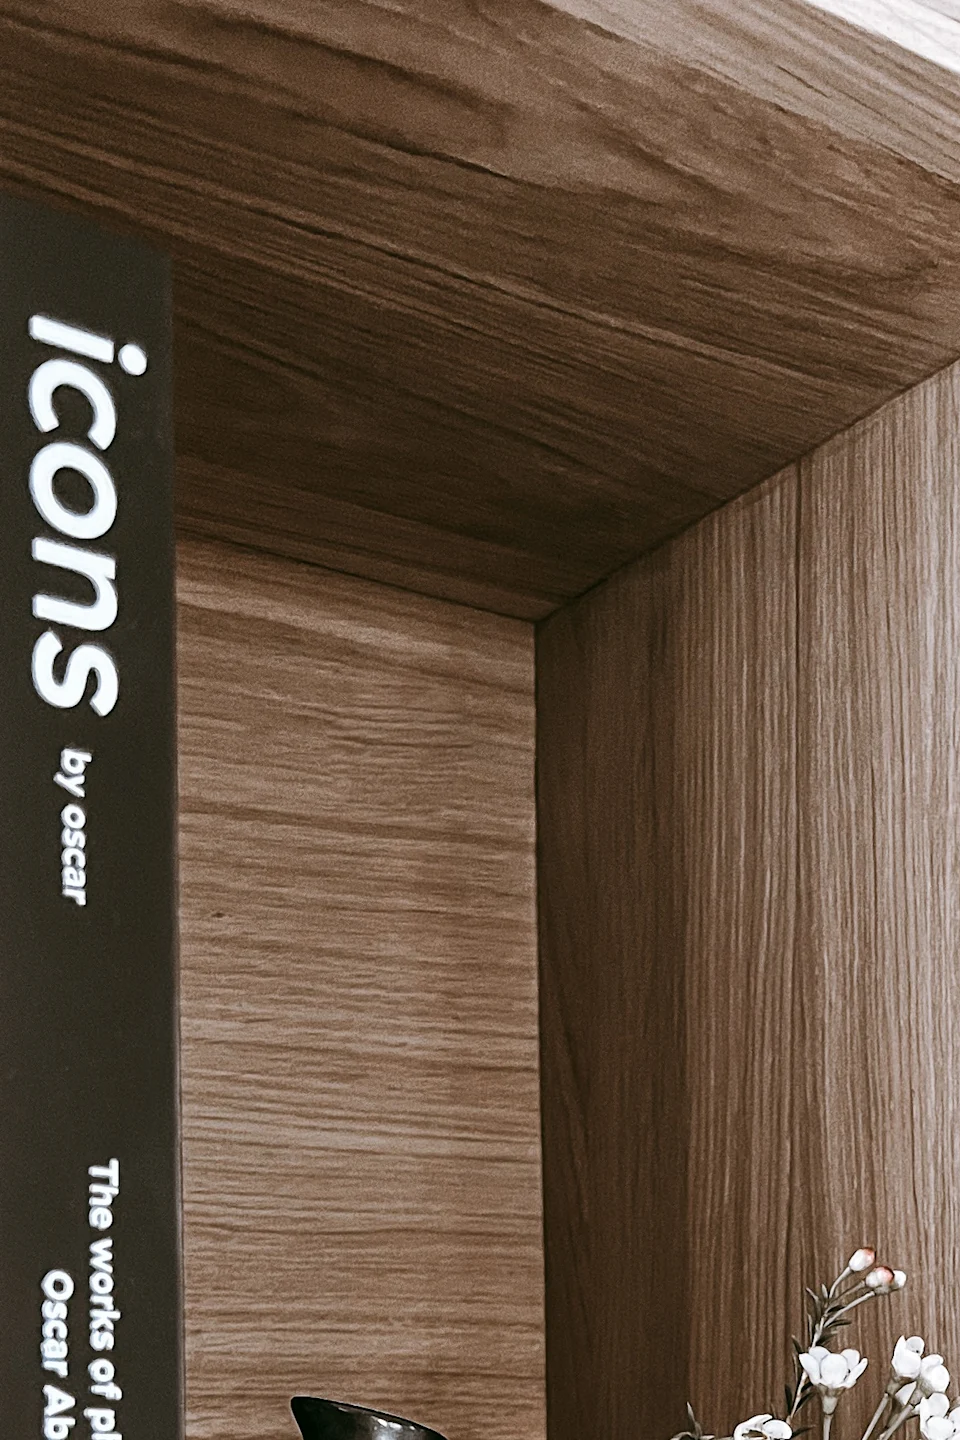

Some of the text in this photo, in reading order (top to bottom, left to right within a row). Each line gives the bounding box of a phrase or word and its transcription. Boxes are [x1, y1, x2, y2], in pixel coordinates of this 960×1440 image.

[28, 314, 148, 717] icons
[54, 748, 92, 906] by oscar
[88, 1158, 120, 1230] The
[40, 1269, 75, 1378] Oscar
[89, 1238, 121, 1351] works
[87, 1358, 123, 1401] of
